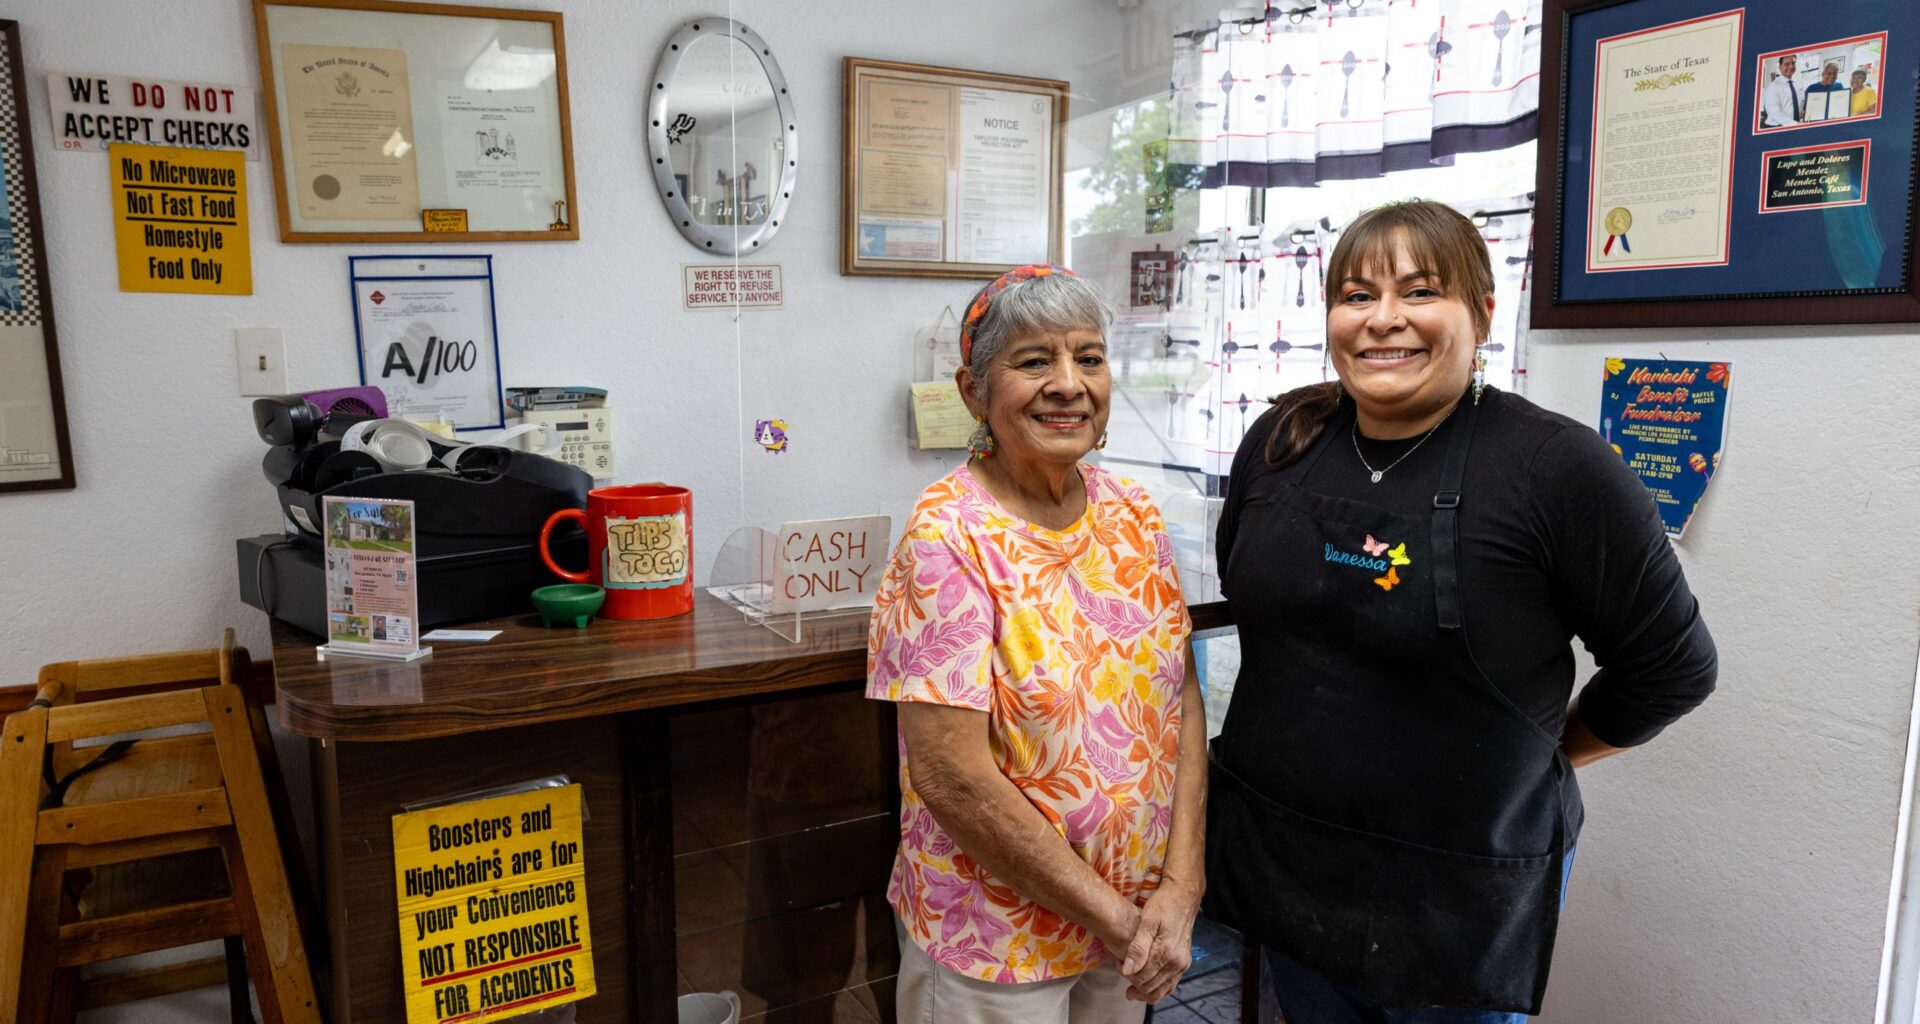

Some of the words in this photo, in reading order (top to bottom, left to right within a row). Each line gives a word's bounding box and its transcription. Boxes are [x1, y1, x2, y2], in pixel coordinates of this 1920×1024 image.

[1624, 68, 1642, 78] The
[1644, 63, 1668, 74] State
[1670, 60, 1682, 70] of
[1682, 56, 1710, 68] Texas
[68, 77, 110, 104] WE
[132, 82, 165, 109] DO
[184, 86, 234, 114] NOT
[64, 112, 154, 142] ACCEPT
[163, 119, 250, 148] CHECKS
[984, 118, 1019, 130] NOTICE
[1777, 160, 1797, 169] Lupe
[1799, 156, 1816, 166] and
[1817, 154, 1851, 164] Dolores
[1796, 166, 1829, 177] Mendez
[122, 158, 143, 182] No
[150, 160, 236, 187] Microwave
[1785, 177, 1817, 187] Mendez
[1818, 174, 1840, 185] Café
[1771, 190, 1788, 198] San
[1789, 186, 1825, 197] Antonio,
[1826, 184, 1852, 193] Texas
[127, 191, 154, 214] Not
[161, 193, 194, 216] Fast
[202, 195, 236, 218] Food
[716, 202, 733, 216] in
[740, 202, 767, 220] TX
[144, 224, 223, 252] Homestyle
[148, 256, 184, 280] Food
[192, 258, 222, 284] Only
[694, 270, 709, 280] WE
[712, 270, 754, 280] RESERVE
[756, 270, 773, 279] THE
[694, 282, 722, 292] RIGHT
[725, 282, 736, 291] TO
[740, 281, 774, 290] REFUSE
[688, 293, 727, 303] SERVICE
[730, 293, 742, 302] TO
[745, 292, 780, 302] ANYONE
[1626, 366, 1700, 385] Mariachi
[1610, 392, 1619, 400] DJ
[1636, 385, 1689, 404] Benefit
[1621, 402, 1702, 422] Fundraiser
[1642, 425, 1682, 434] PERFORMANCE
[1630, 460, 1649, 469] MAY
[1650, 462, 1658, 471] 2,
[1660, 464, 1682, 473] 2026
[1635, 452, 1678, 464] SATURDAY
[1638, 470, 1673, 479] 11AM-2PM
[609, 521, 672, 552] TIPS
[782, 531, 866, 564] CASH
[1324, 542, 1388, 572] Vanessa
[784, 564, 872, 600] ONLY
[429, 815, 512, 852] Boosters
[521, 803, 552, 834] and
[405, 855, 502, 898] Highchairs
[512, 849, 542, 876] are
[550, 840, 578, 867] for
[415, 904, 458, 942] your
[467, 880, 576, 925] Convenience
[418, 942, 455, 979] NOT
[464, 915, 580, 969] RESPONSIBLE
[434, 983, 470, 1020] FOR
[480, 958, 575, 1010] ACCIDENTS
